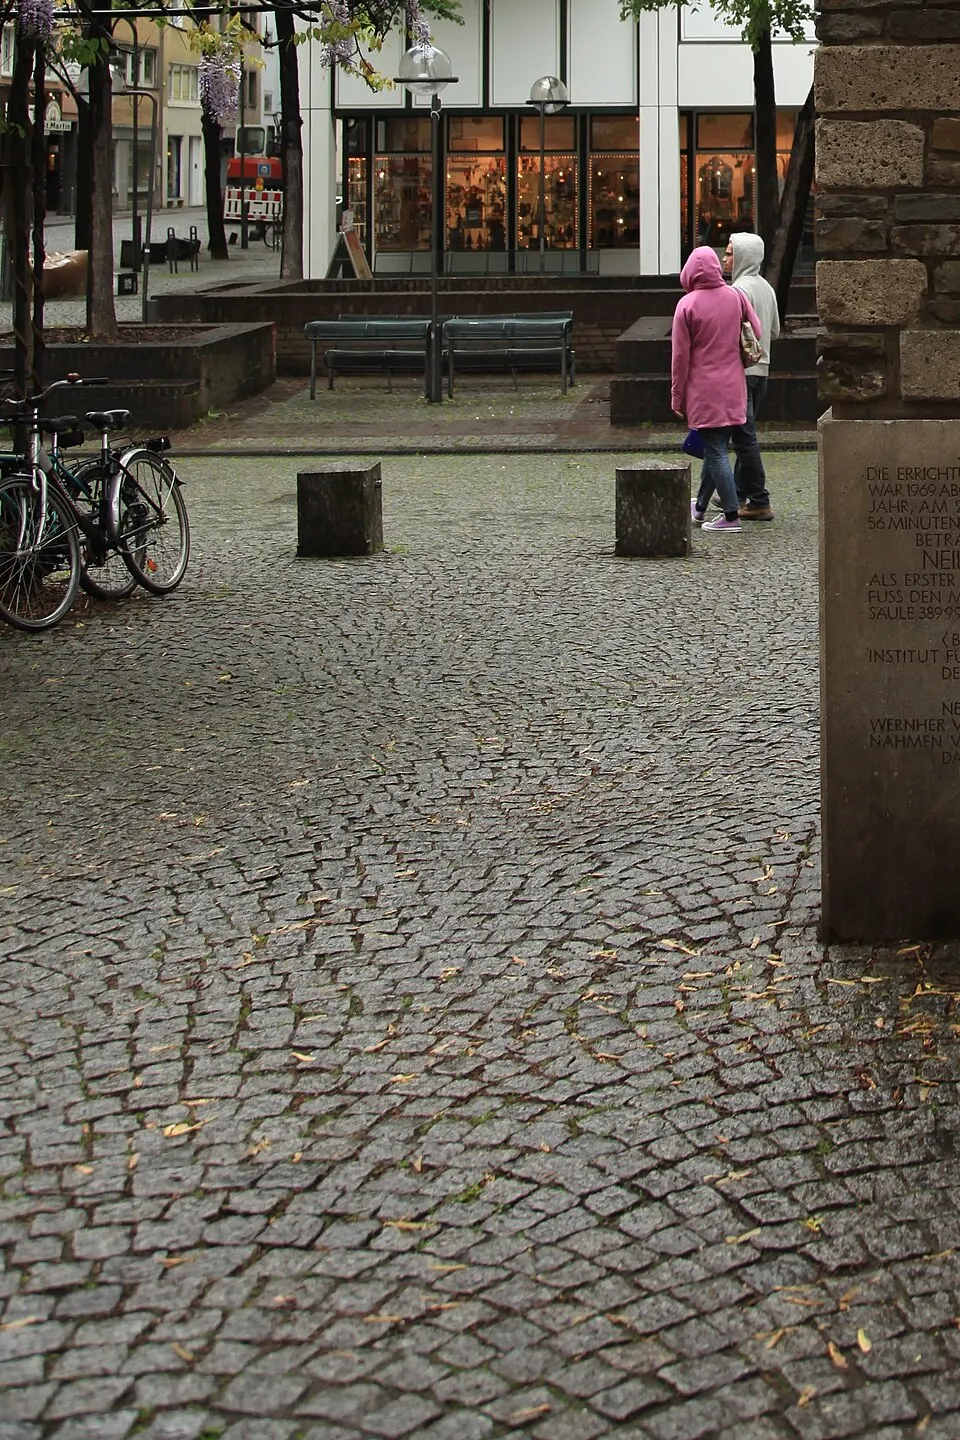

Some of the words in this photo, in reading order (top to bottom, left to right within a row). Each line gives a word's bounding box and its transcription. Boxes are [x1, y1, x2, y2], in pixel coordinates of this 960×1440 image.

[866, 466, 889, 481] DIE
[868, 483, 903, 497] WAR
[907, 483, 937, 497] 1969
[868, 499, 914, 514] JAHR,
[918, 499, 948, 514] AM
[868, 517, 885, 530] 56
[888, 517, 960, 530] MINUTEN
[869, 573, 897, 587] ALS
[905, 573, 955, 587] ERSTER
[868, 590, 902, 604] FUSS
[909, 590, 941, 604] DEN
[869, 606, 915, 620] SÄULE
[869, 649, 938, 663] INSTITUT
[869, 718, 945, 733] WERNHER
[869, 735, 942, 749] NAHMEN
